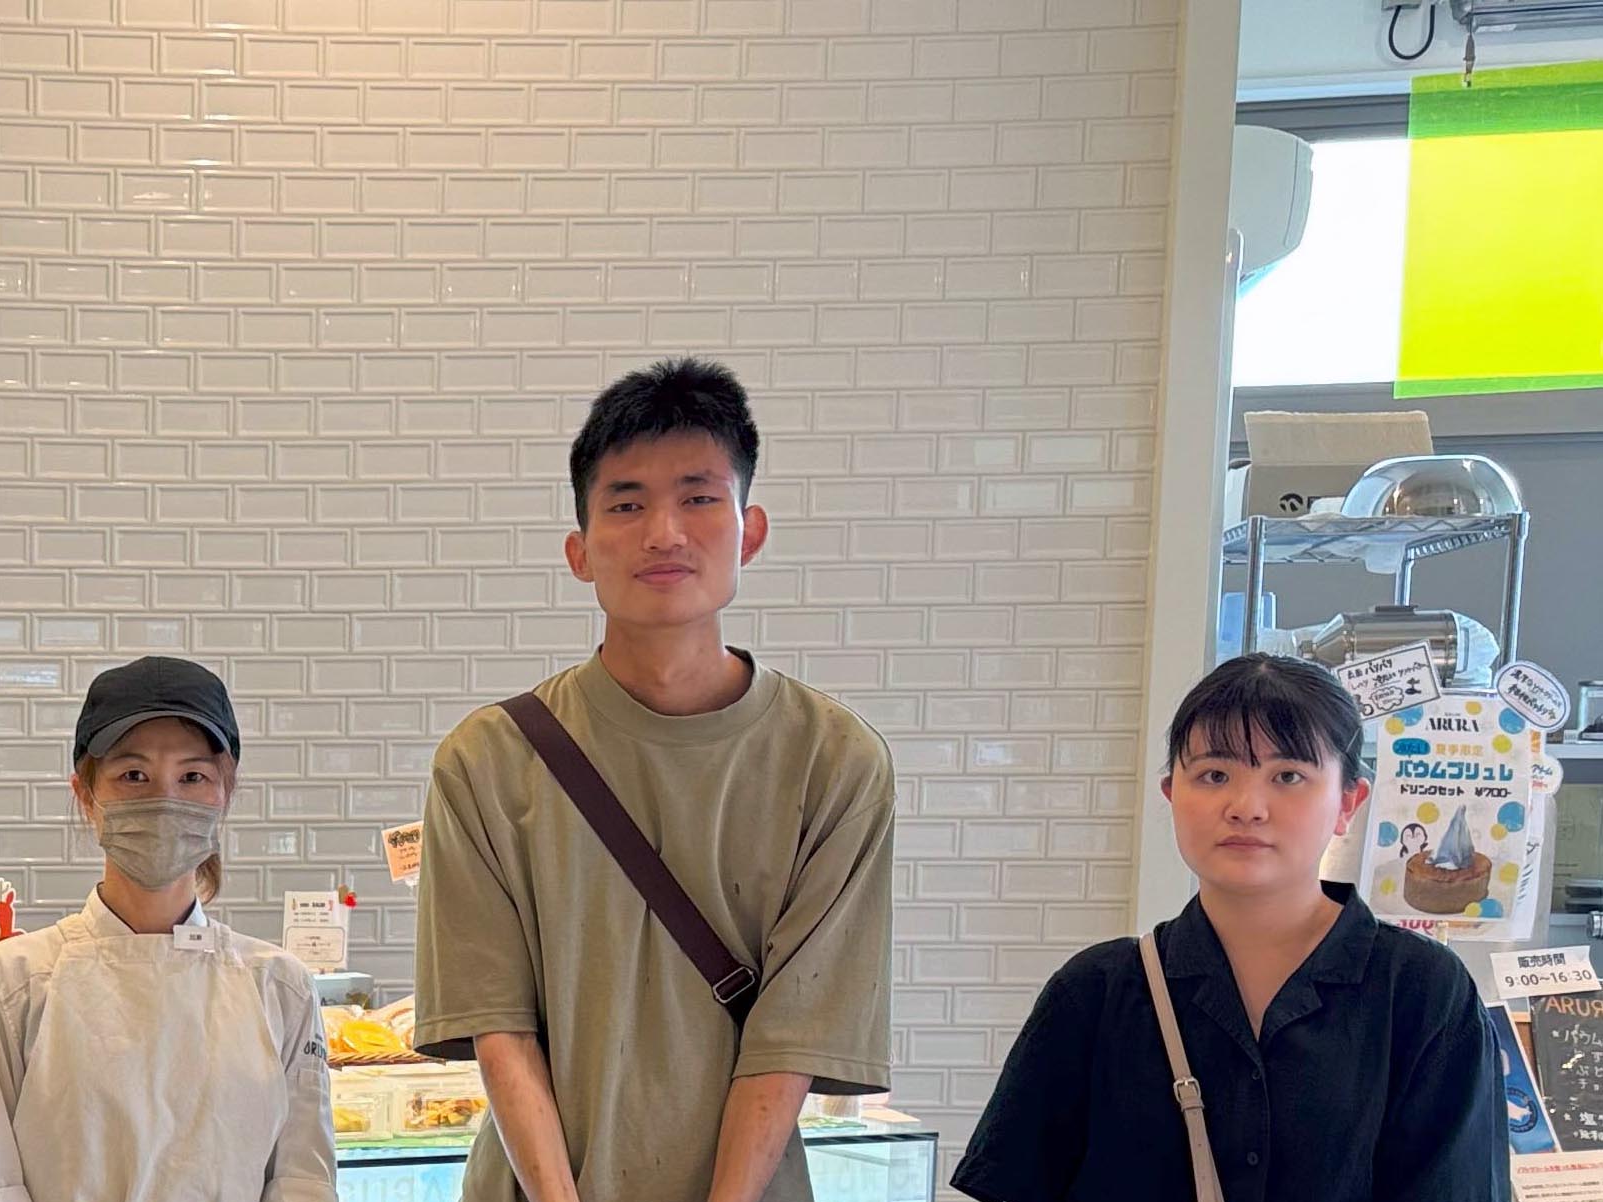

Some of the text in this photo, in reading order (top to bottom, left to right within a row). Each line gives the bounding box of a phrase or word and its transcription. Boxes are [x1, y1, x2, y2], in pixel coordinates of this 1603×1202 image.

[1425, 717, 1480, 732] ARURA
[1400, 783, 1465, 797] ドリンクセット
[1518, 953, 1566, 968] 販売時間
